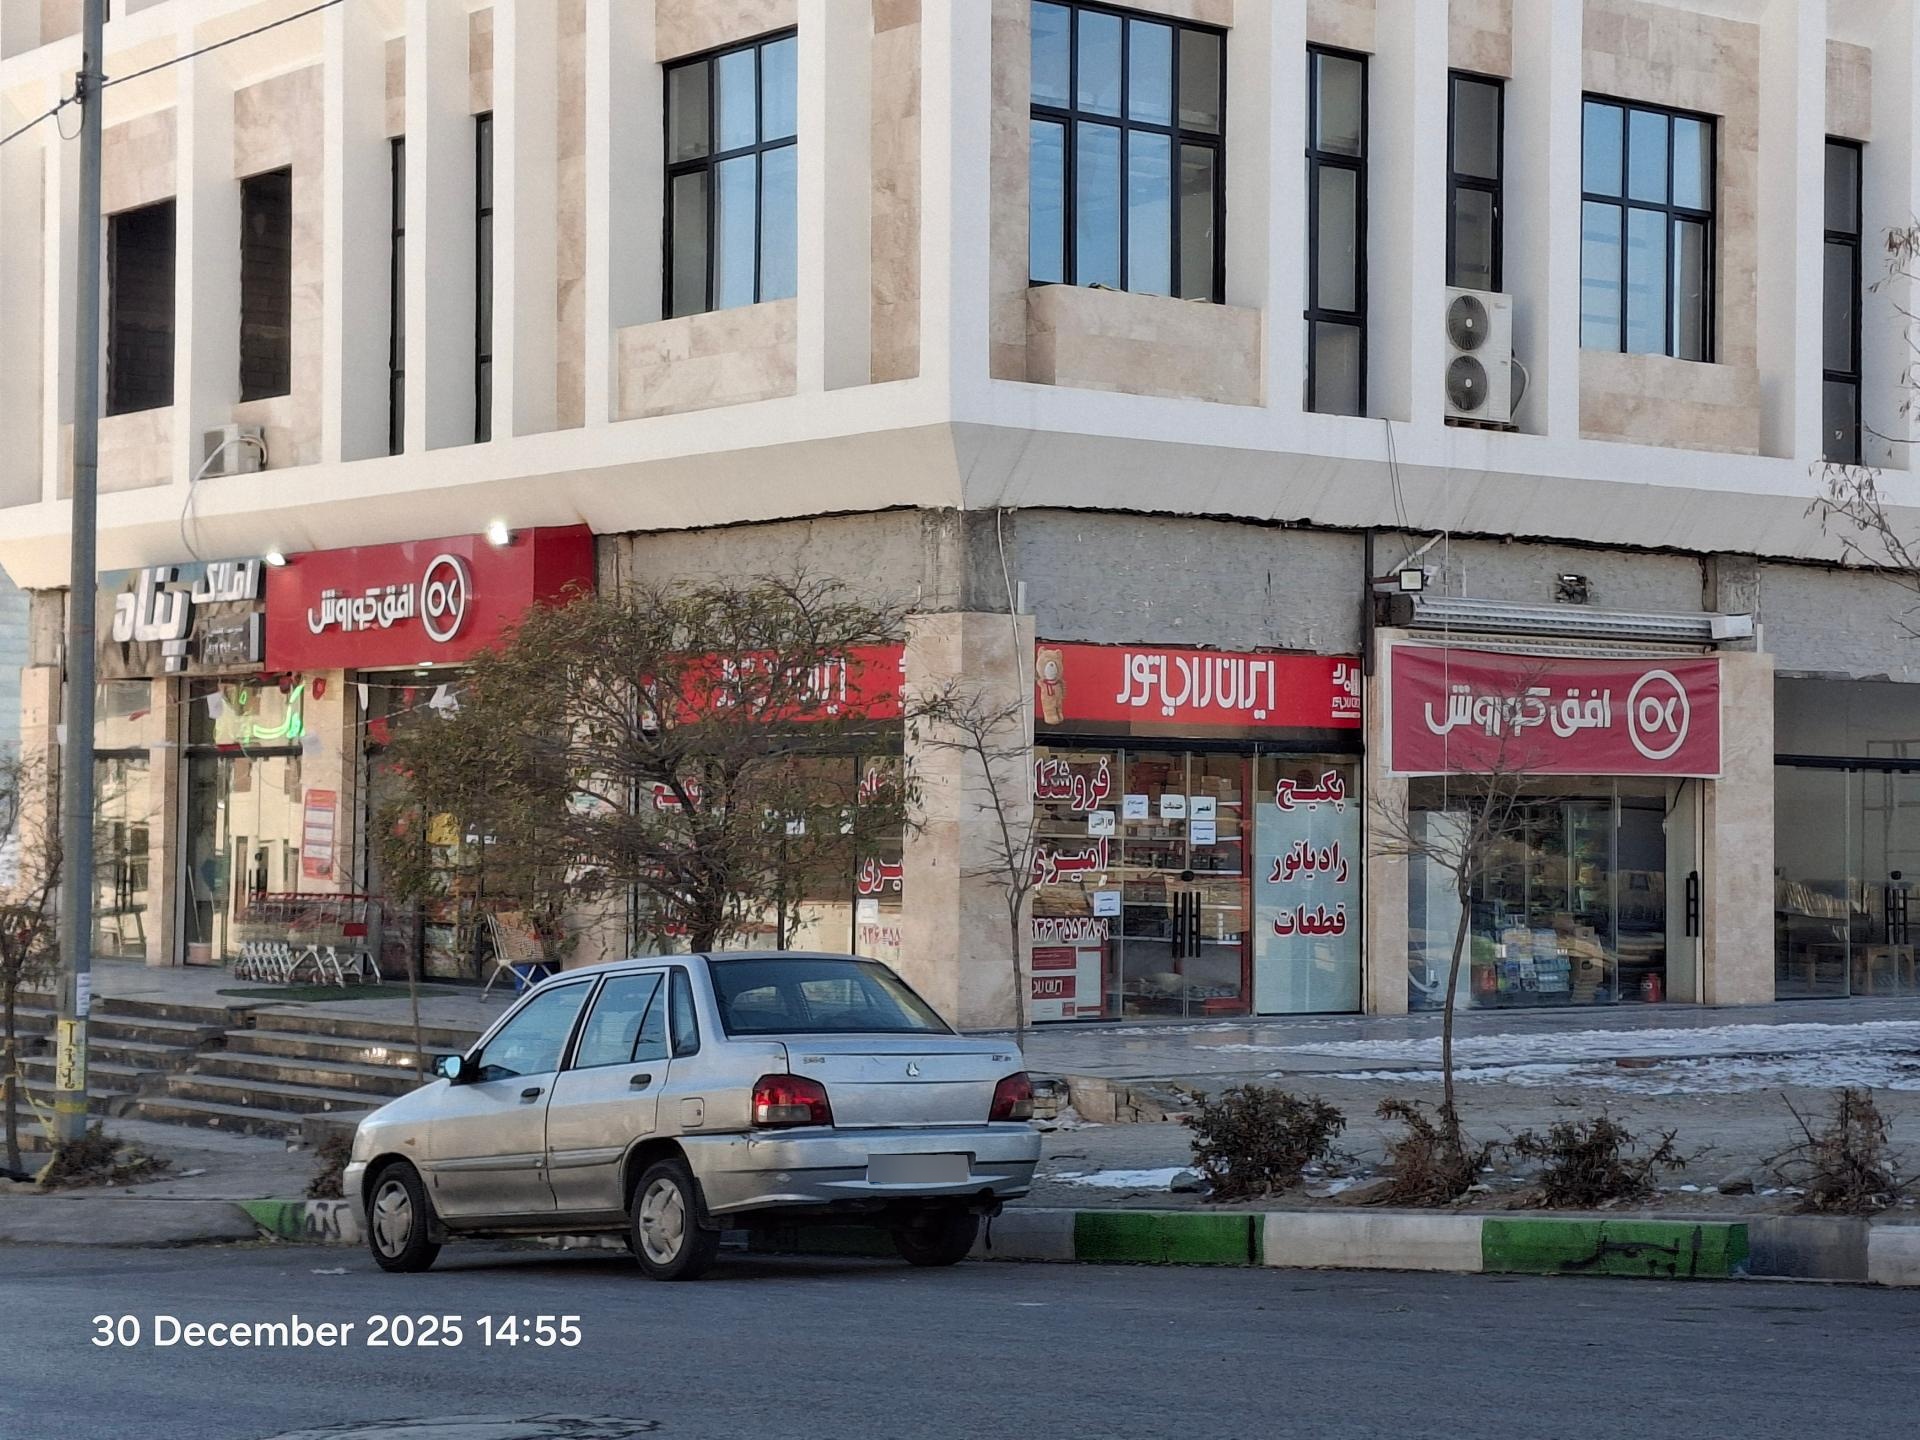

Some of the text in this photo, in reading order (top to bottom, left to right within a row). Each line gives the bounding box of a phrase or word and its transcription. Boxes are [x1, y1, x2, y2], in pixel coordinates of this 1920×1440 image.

[307, 583, 415, 634] افق کوروش
[1116, 653, 1212, 717] رادیاتور
[1216, 657, 1275, 720] ایران
[1425, 685, 1611, 738] افق کوروش
[1034, 756, 1110, 811] فروشگا
[1276, 769, 1345, 814] پکیج
[1032, 835, 1108, 885] امیری
[1268, 838, 1349, 884] رادیاتور
[1273, 902, 1348, 937] قطعات
